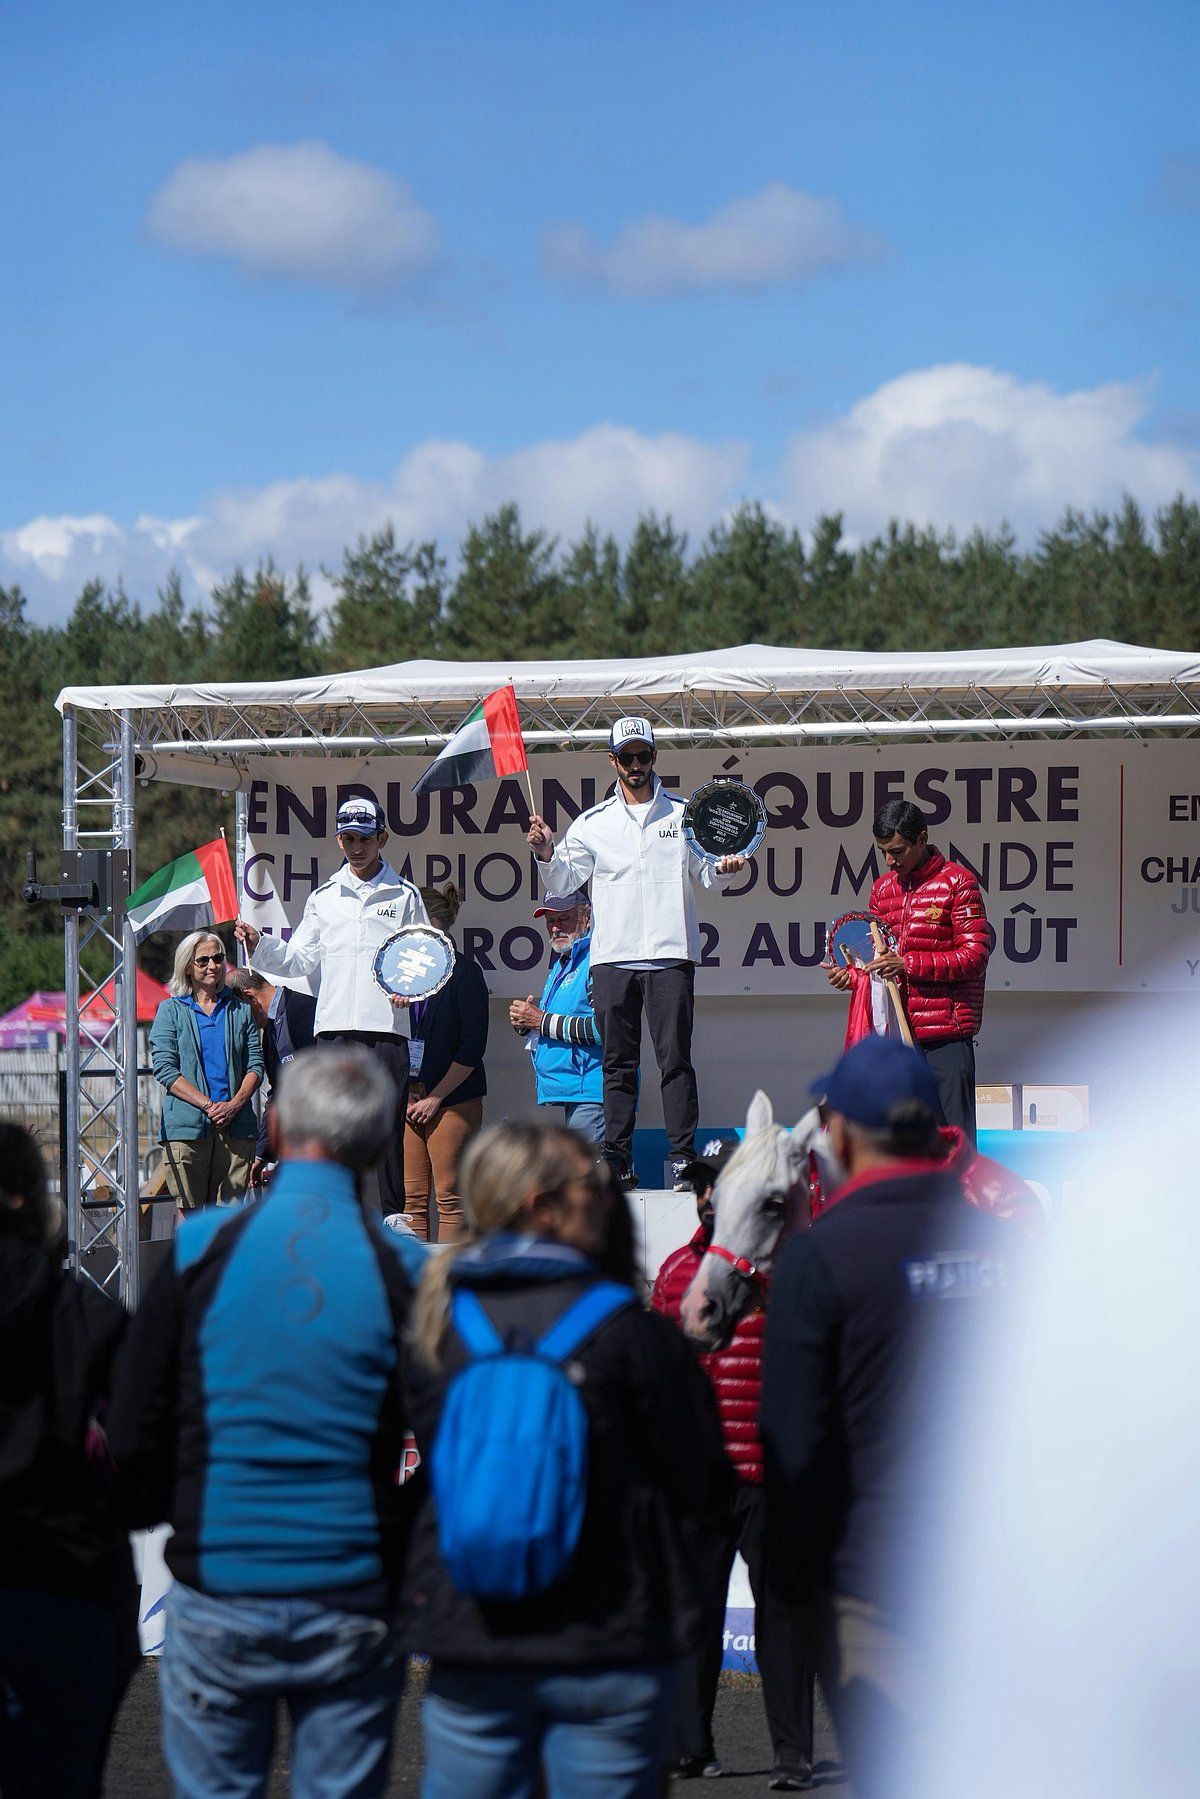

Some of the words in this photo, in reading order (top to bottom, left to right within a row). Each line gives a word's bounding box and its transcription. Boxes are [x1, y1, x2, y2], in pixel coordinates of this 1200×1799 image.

[623, 727, 642, 736] UAE
[658, 830, 679, 839] UAE
[831, 841, 1074, 896] MNDE
[376, 908, 397, 919] UAE
[741, 921, 826, 967] AU
